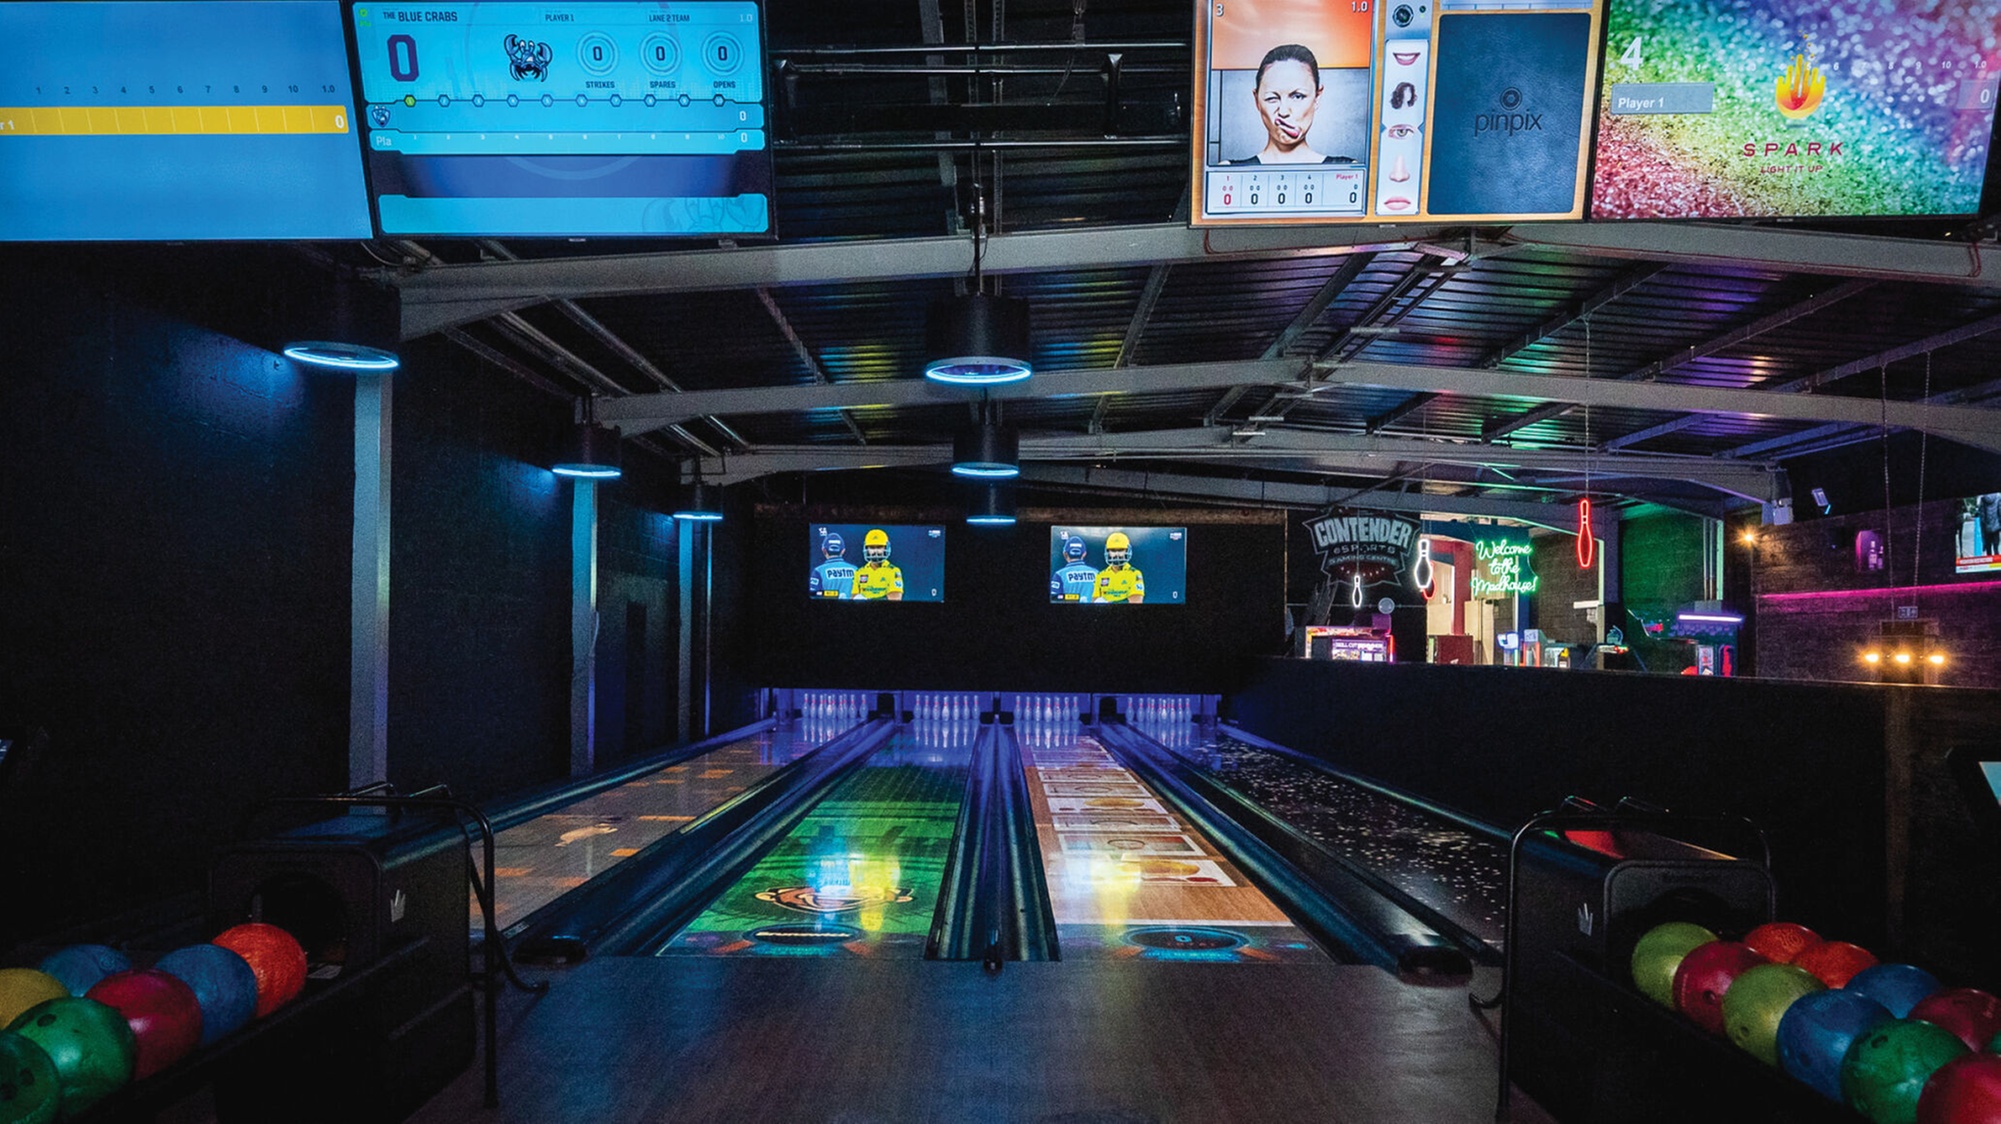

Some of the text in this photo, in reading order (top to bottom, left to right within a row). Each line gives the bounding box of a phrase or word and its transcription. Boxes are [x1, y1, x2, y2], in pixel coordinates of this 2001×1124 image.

[1216, 4, 1224, 17] 3
[1351, 1, 1368, 12] 1.0
[398, 12, 422, 22] BLUE
[425, 12, 458, 22] CRABS
[545, 14, 569, 22] PLAYER
[649, 14, 690, 22] LANE 2 TEAM
[387, 34, 419, 82] 0
[593, 46, 602, 61] 0
[656, 46, 665, 61] 0
[718, 46, 728, 61] 0
[1620, 36, 1644, 71] 4
[1833, 62, 1839, 70] 6
[1888, 62, 1894, 70] 8
[1916, 61, 1921, 69] 9
[1942, 61, 1951, 69] 10
[1975, 61, 1986, 69] 1.0
[92, 86, 98, 94] 3
[121, 86, 127, 94] 4
[149, 86, 155, 94] 5
[177, 86, 183, 94] 6
[262, 85, 268, 93] 9
[288, 85, 299, 93] 10
[322, 85, 335, 93] 1.0
[1980, 89, 1990, 103] 0
[1618, 97, 1664, 111] Player 1
[335, 115, 344, 129] 0
[740, 111, 747, 121] 0
[8, 120, 15, 130] 1
[1474, 109, 1543, 136] pinpix
[376, 136, 392, 146] Pla
[741, 132, 748, 143] 0
[1743, 142, 1843, 157] SPARK
[1760, 166, 1792, 174] LIGHT
[1808, 165, 1823, 173] UP
[1224, 193, 1231, 205] 0
[1251, 193, 1258, 205] 0
[1278, 193, 1286, 204] 0
[1305, 192, 1312, 204] 0
[1349, 192, 1357, 204] 0
[1314, 517, 1413, 548] CONTENDER
[1476, 539, 1532, 560] Welcome
[1488, 557, 1520, 575] to the
[1471, 576, 1538, 596] Madhouse!
